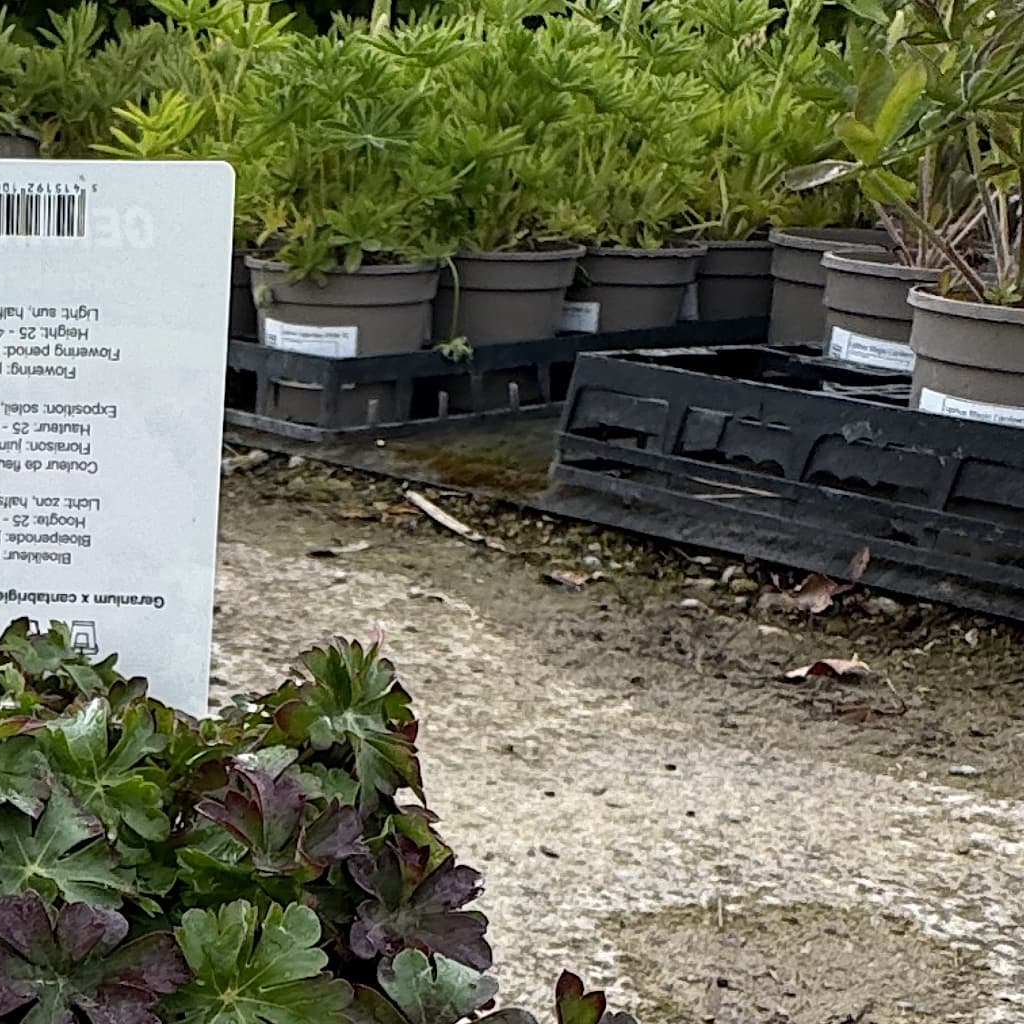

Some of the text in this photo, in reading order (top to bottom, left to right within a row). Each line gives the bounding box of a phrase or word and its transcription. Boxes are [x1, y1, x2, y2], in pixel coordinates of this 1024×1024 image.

[27, 182, 79, 193] 415192
[19, 327, 36, 340] 25
[40, 324, 88, 340] Height:
[4, 344, 50, 358] period:
[54, 343, 120, 361] Flowering
[7, 362, 76, 379] Flowering:
[1, 402, 39, 416] soleil,
[43, 402, 117, 418] Exposition:
[12, 422, 29, 435] 25
[26, 441, 90, 455] Floraison:
[25, 460, 42, 472] de
[46, 460, 98, 474] Couleur
[32, 496, 60, 507] zon,
[64, 498, 100, 511] Licht:
[12, 514, 29, 527] 25
[33, 512, 86, 528] Hoogte:
[6, 531, 91, 547] Bloeiperiode:
[3, 551, 71, 565] Bloeikleur:
[81, 594, 90, 603] x
[93, 594, 165, 609] Geranium
